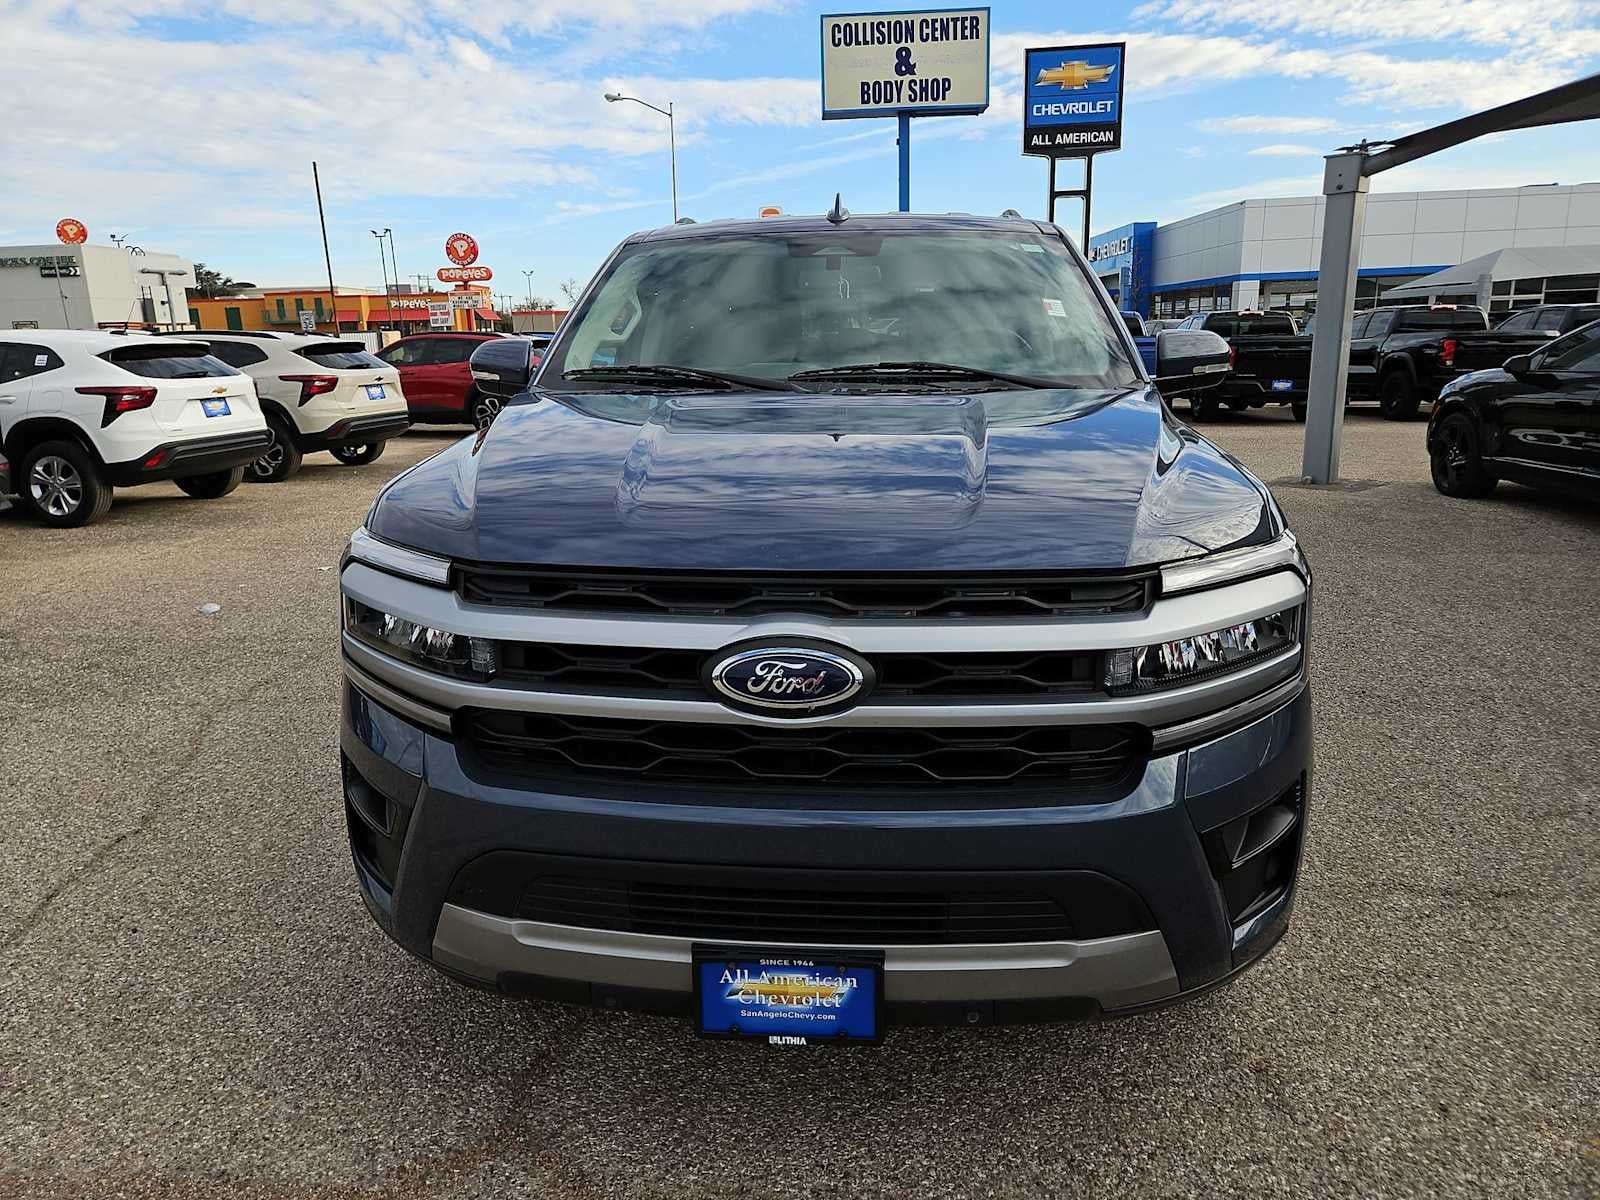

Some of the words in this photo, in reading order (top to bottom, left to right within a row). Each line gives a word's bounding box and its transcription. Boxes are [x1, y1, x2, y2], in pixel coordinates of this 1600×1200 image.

[831, 20, 915, 48] COLLISION
[919, 15, 980, 43] CENTER
[894, 46, 917, 76] &
[860, 79, 907, 105] BODY
[908, 78, 952, 103] SHOP
[1032, 100, 1114, 117] CHEVROLET
[1031, 132, 1053, 146] ALL
[1055, 130, 1114, 145] AMERICAN
[747, 661, 826, 693] Ford
[759, 958, 790, 967] SINCE
[793, 959, 815, 967] 1966
[719, 968, 749, 985] All
[759, 970, 858, 988] American
[739, 989, 841, 1009] Chevrolet
[740, 1009, 836, 1021] SanAngeloChevy.com
[777, 1036, 807, 1046] LITHIA
